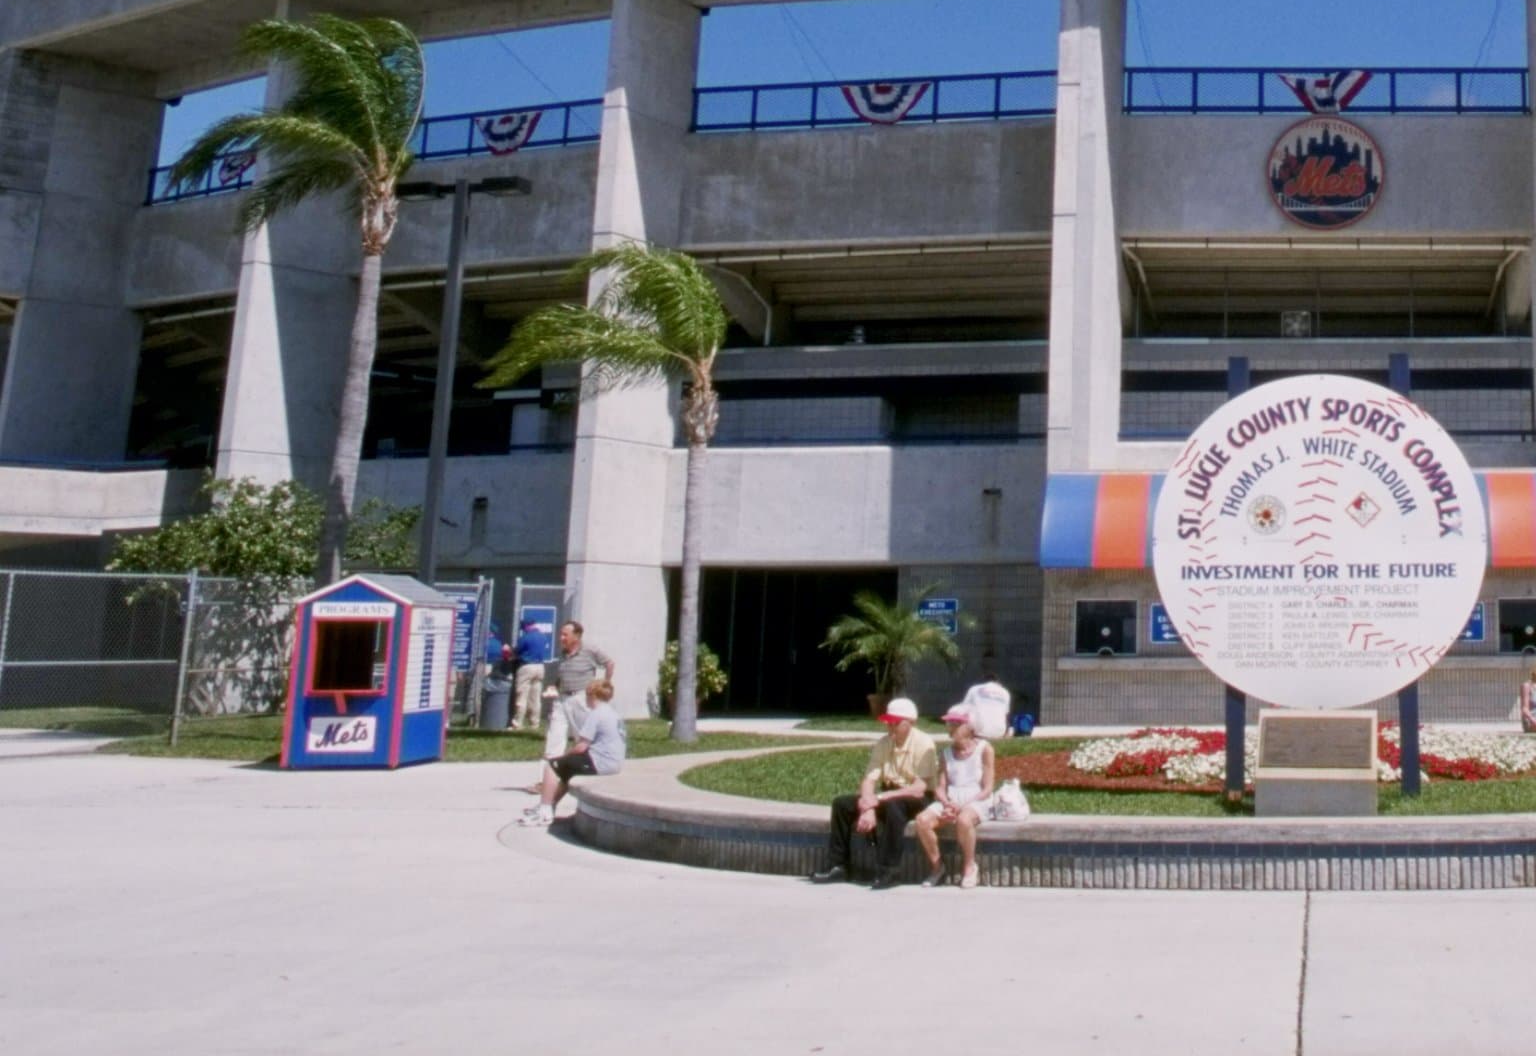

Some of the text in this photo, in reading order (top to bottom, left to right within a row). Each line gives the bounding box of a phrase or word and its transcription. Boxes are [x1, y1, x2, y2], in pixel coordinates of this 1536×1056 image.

[1284, 155, 1366, 197] Mets
[1184, 443, 1231, 501] LUCIE
[1227, 396, 1311, 450] COUNTY
[1321, 398, 1405, 442] SPORTS
[1403, 439, 1463, 538] COMPLEX
[1220, 437, 1417, 517] THOMAS J. WHITE STADIUM
[1181, 563, 1457, 580] INVESTMENT FOR THE FUTURE
[1217, 584, 1419, 596] STADIUM IMPROVEMENT PROJECT
[318, 605, 389, 614] PROGRAMS
[315, 720, 368, 748] Mets
